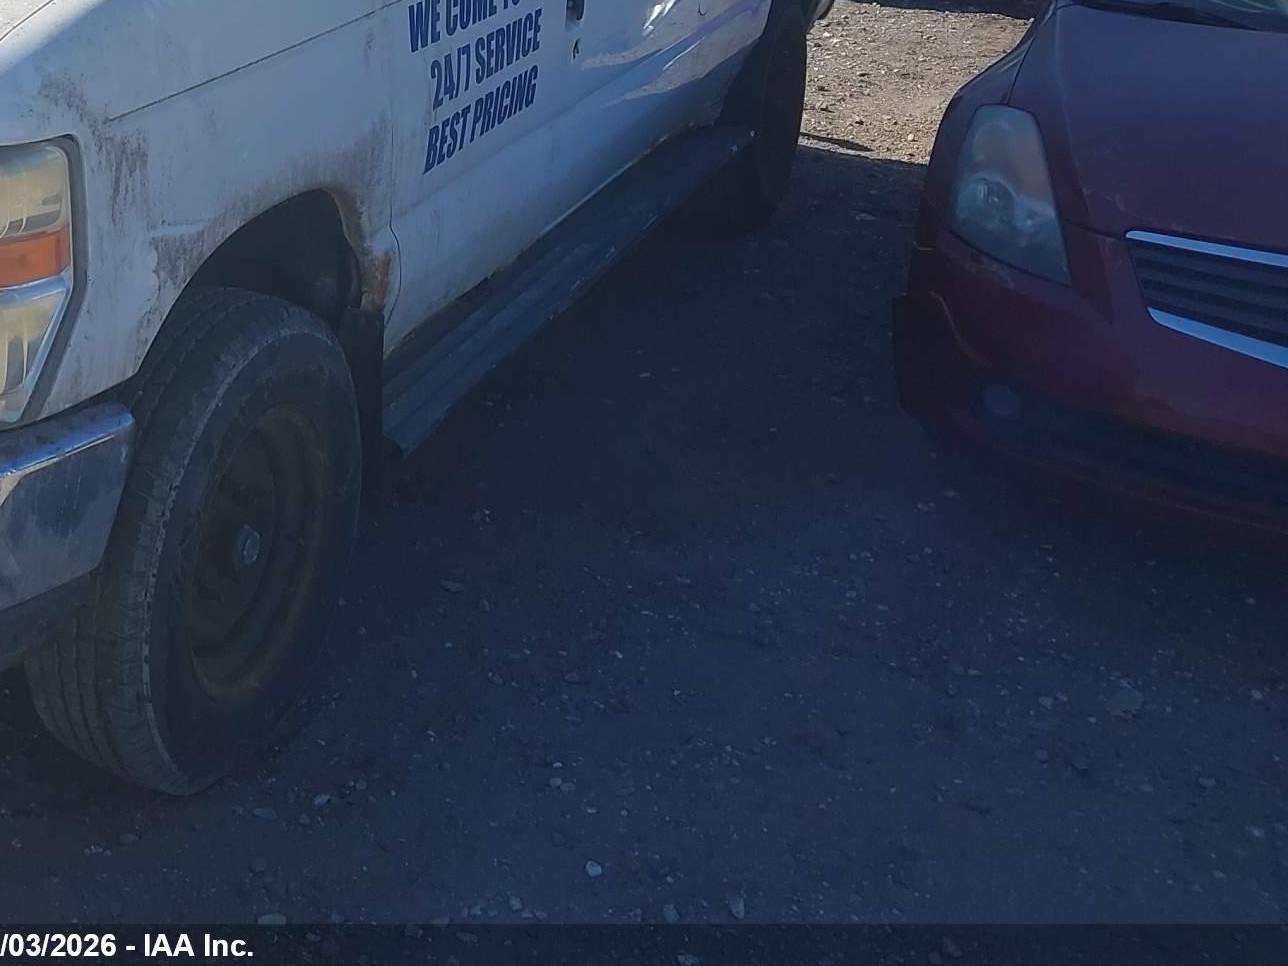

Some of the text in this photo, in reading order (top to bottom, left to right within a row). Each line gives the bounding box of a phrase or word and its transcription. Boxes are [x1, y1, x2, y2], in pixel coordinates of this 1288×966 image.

[430, 7, 543, 111] 24/7 SERVICE
[423, 64, 539, 175] BEST PRICING
